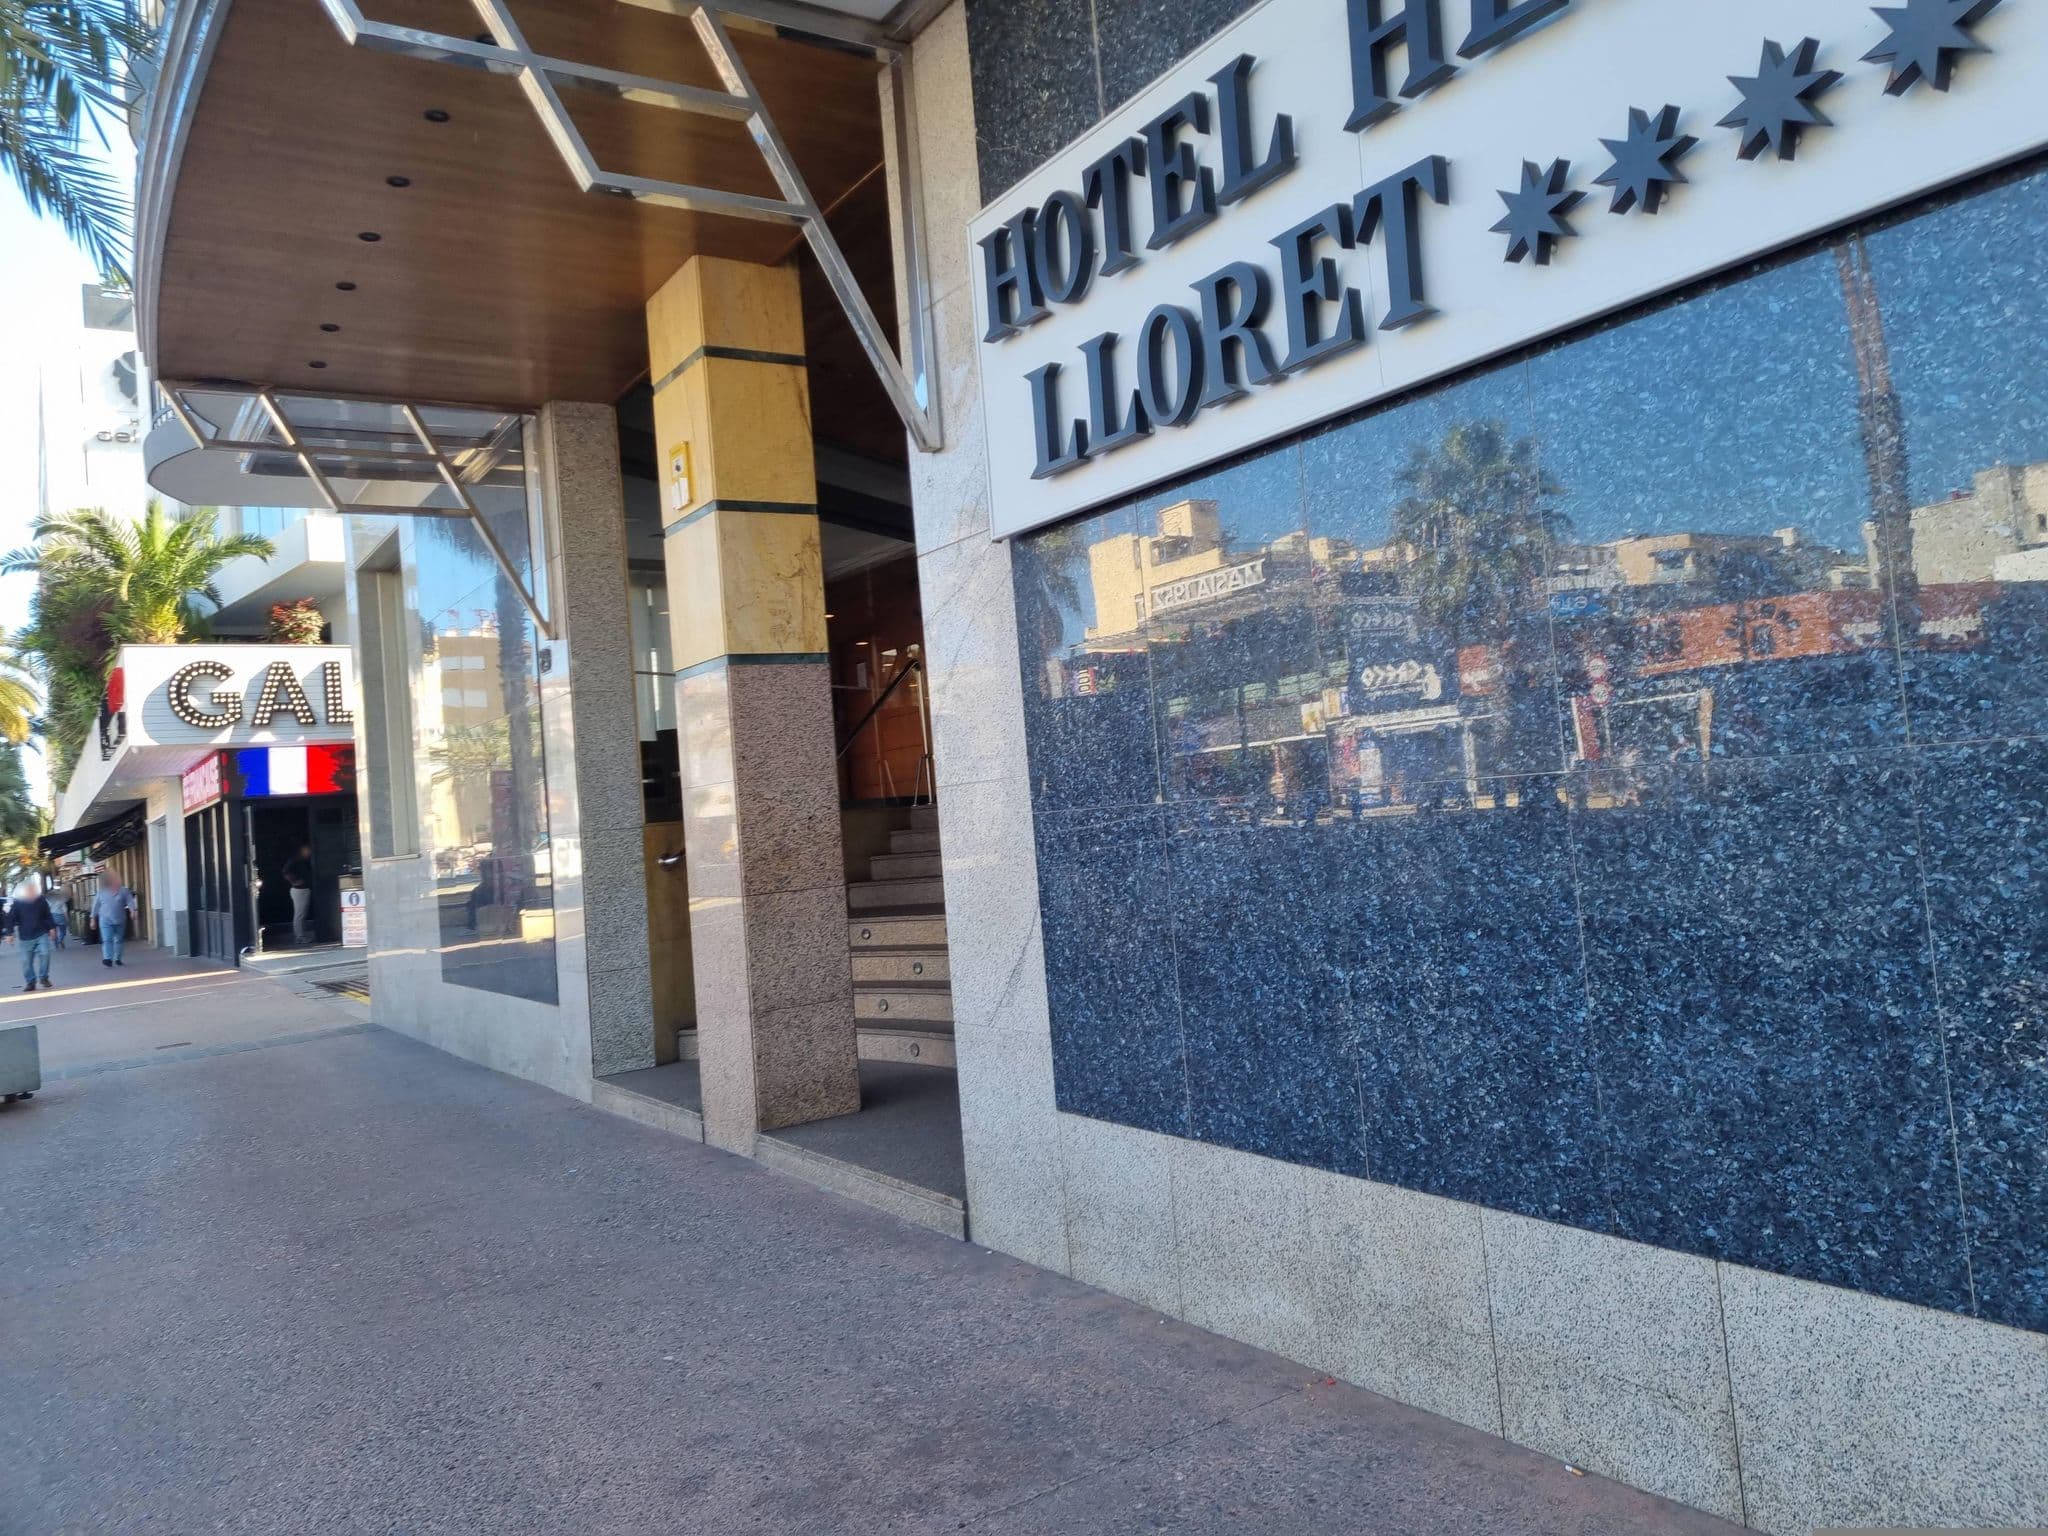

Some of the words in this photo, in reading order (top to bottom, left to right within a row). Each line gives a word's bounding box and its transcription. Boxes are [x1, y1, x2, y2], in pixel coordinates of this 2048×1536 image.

[976, 53, 1298, 343] HOTEL
[1023, 154, 1450, 479] LLORET
[168, 660, 354, 728] GAL
